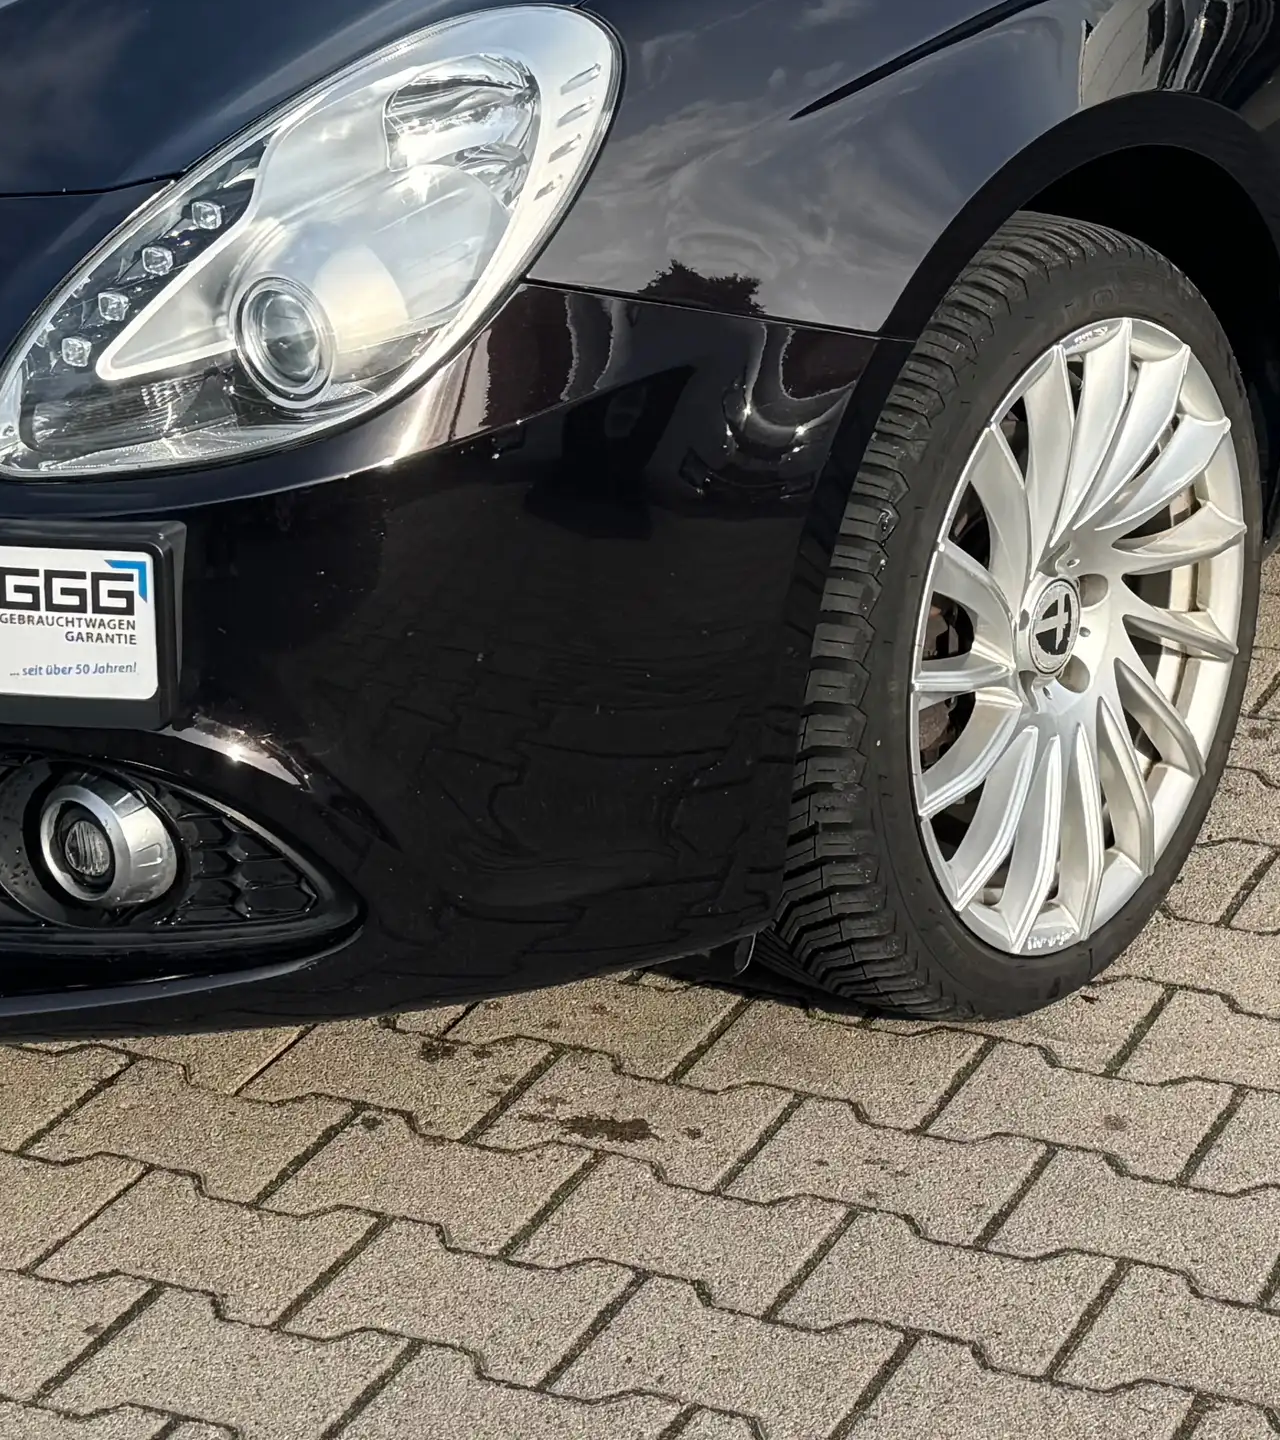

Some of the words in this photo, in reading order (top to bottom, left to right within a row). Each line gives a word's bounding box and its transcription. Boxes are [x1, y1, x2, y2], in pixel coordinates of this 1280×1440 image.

[65, 630, 138, 646] GARANTIE
[22, 664, 44, 677] seit
[45, 662, 73, 676] über
[75, 663, 90, 676] 50
[92, 661, 137, 676] Jahren!
